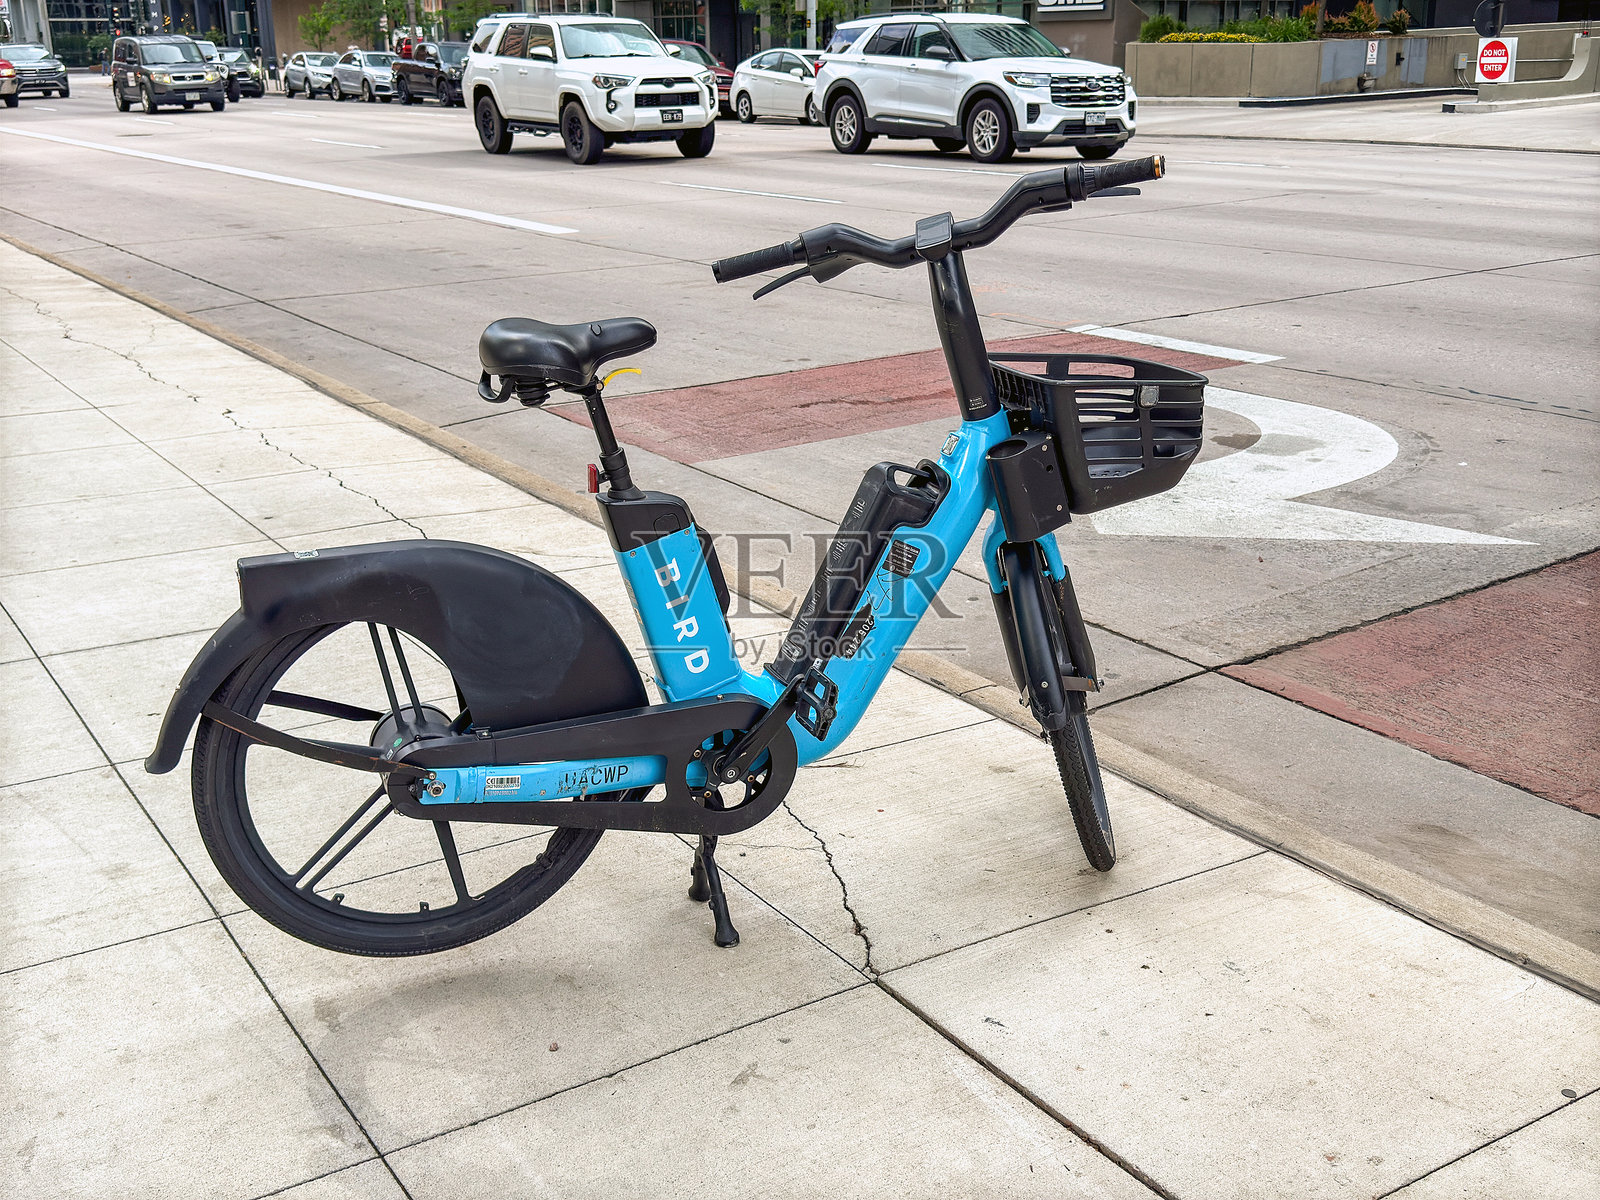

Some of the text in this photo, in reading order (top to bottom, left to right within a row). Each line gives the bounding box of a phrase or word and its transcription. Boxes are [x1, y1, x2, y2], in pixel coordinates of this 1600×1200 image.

[1483, 49, 1506, 57] DO NOT
[1483, 64, 1503, 72] ENTER
[655, 557, 710, 674] BIRD
